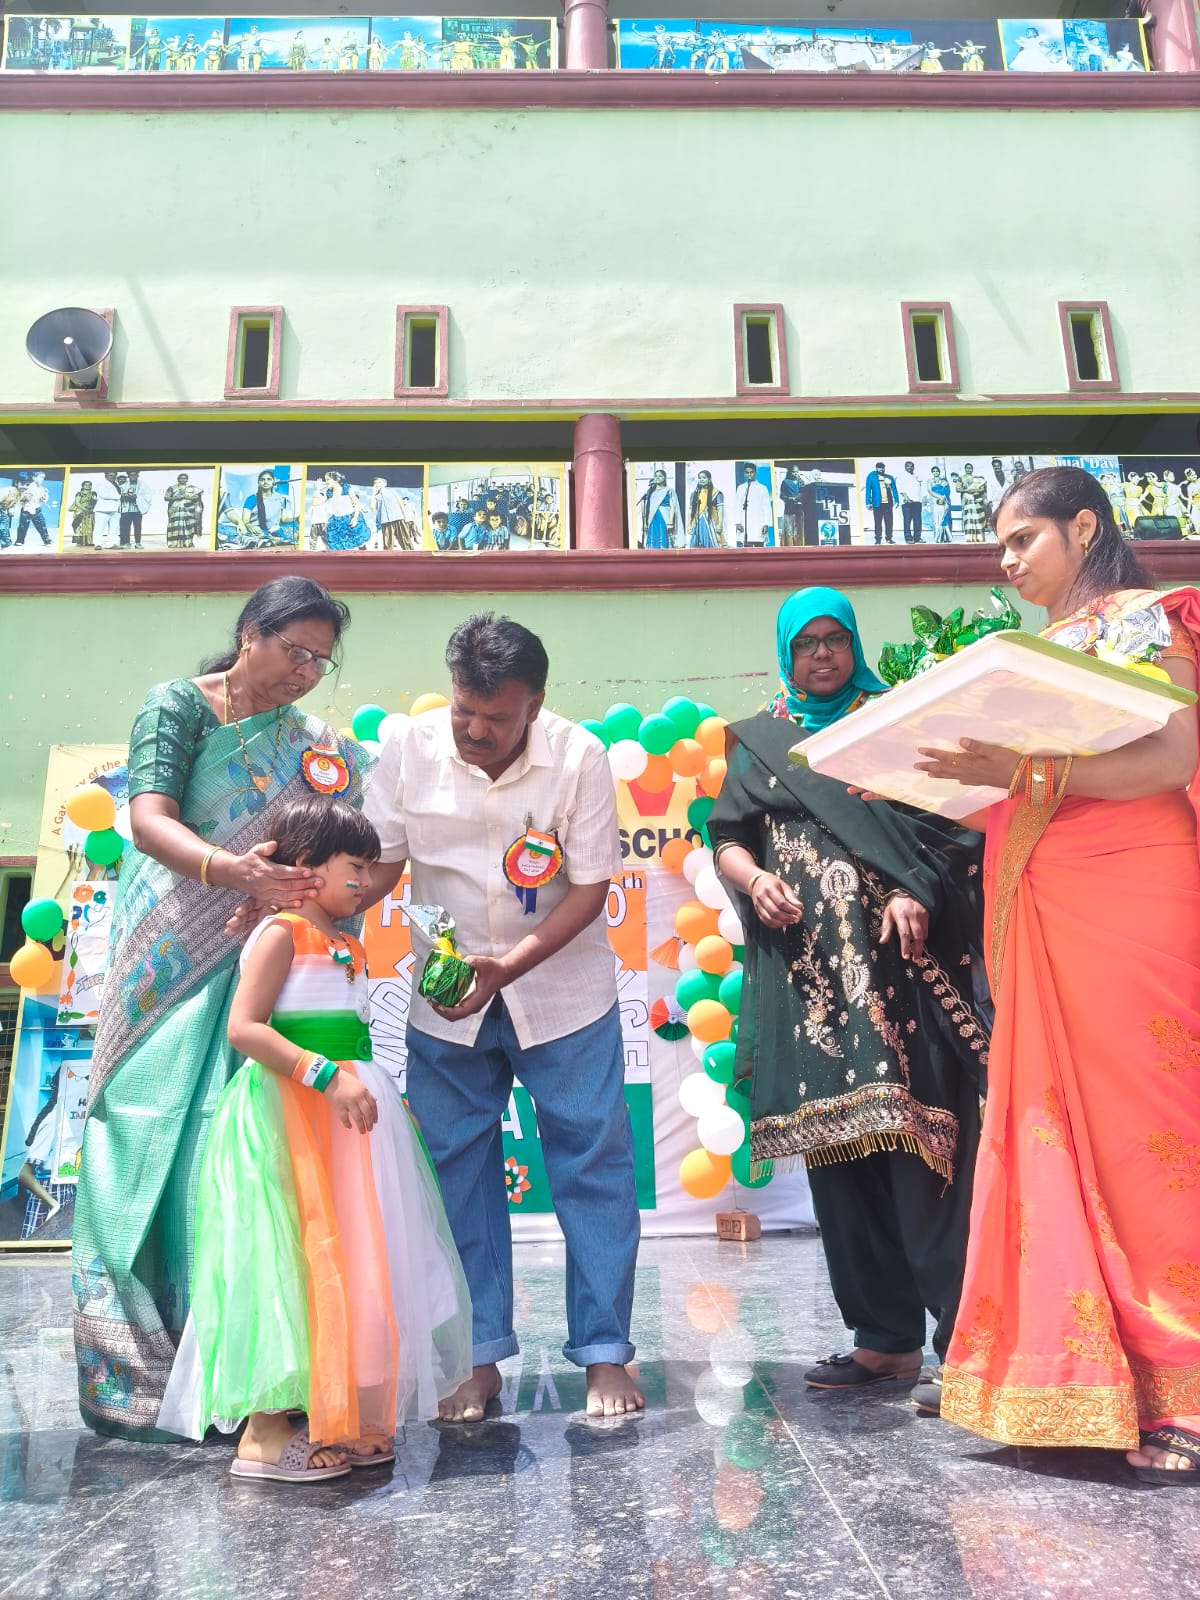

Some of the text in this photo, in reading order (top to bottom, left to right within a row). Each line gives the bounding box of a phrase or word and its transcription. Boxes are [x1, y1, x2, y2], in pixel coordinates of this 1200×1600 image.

[1089, 457, 1114, 470] Day
[51, 828, 62, 836] A
[88, 766, 99, 780] of
[102, 760, 121, 772] the
